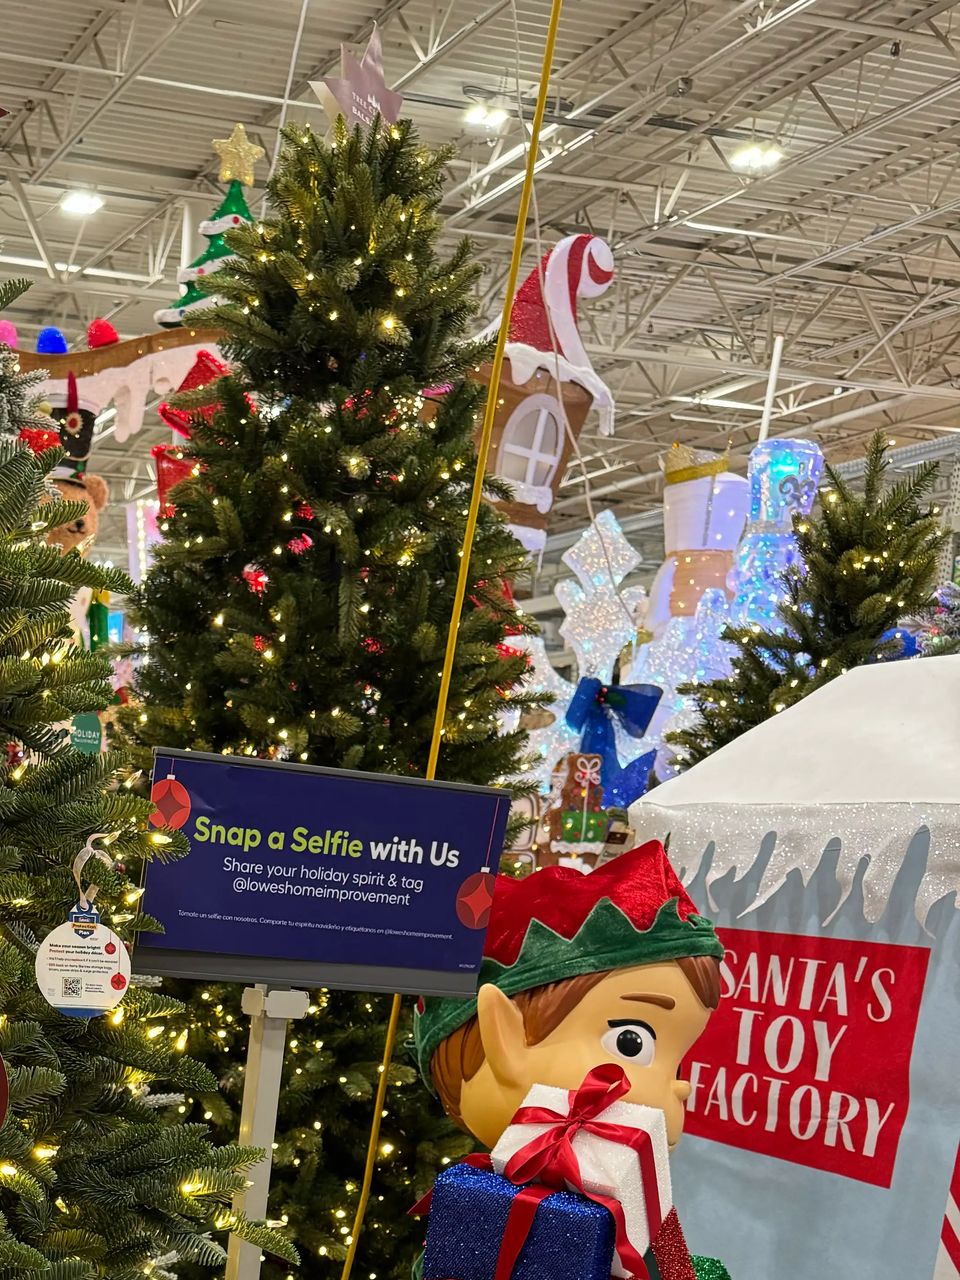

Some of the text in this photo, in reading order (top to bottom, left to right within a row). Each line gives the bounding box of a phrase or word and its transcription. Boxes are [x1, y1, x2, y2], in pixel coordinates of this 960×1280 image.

[194, 816, 460, 867] Snap a Selfie with Us
[223, 857, 424, 892] Share your holiday spirit & tag
[233, 877, 411, 906] @loweshomeimprovement
[259, 918, 288, 926] Comporte
[719, 949, 896, 1023] SANTA'S
[732, 1007, 848, 1082] TOY
[686, 1061, 895, 1158] FACTORY
